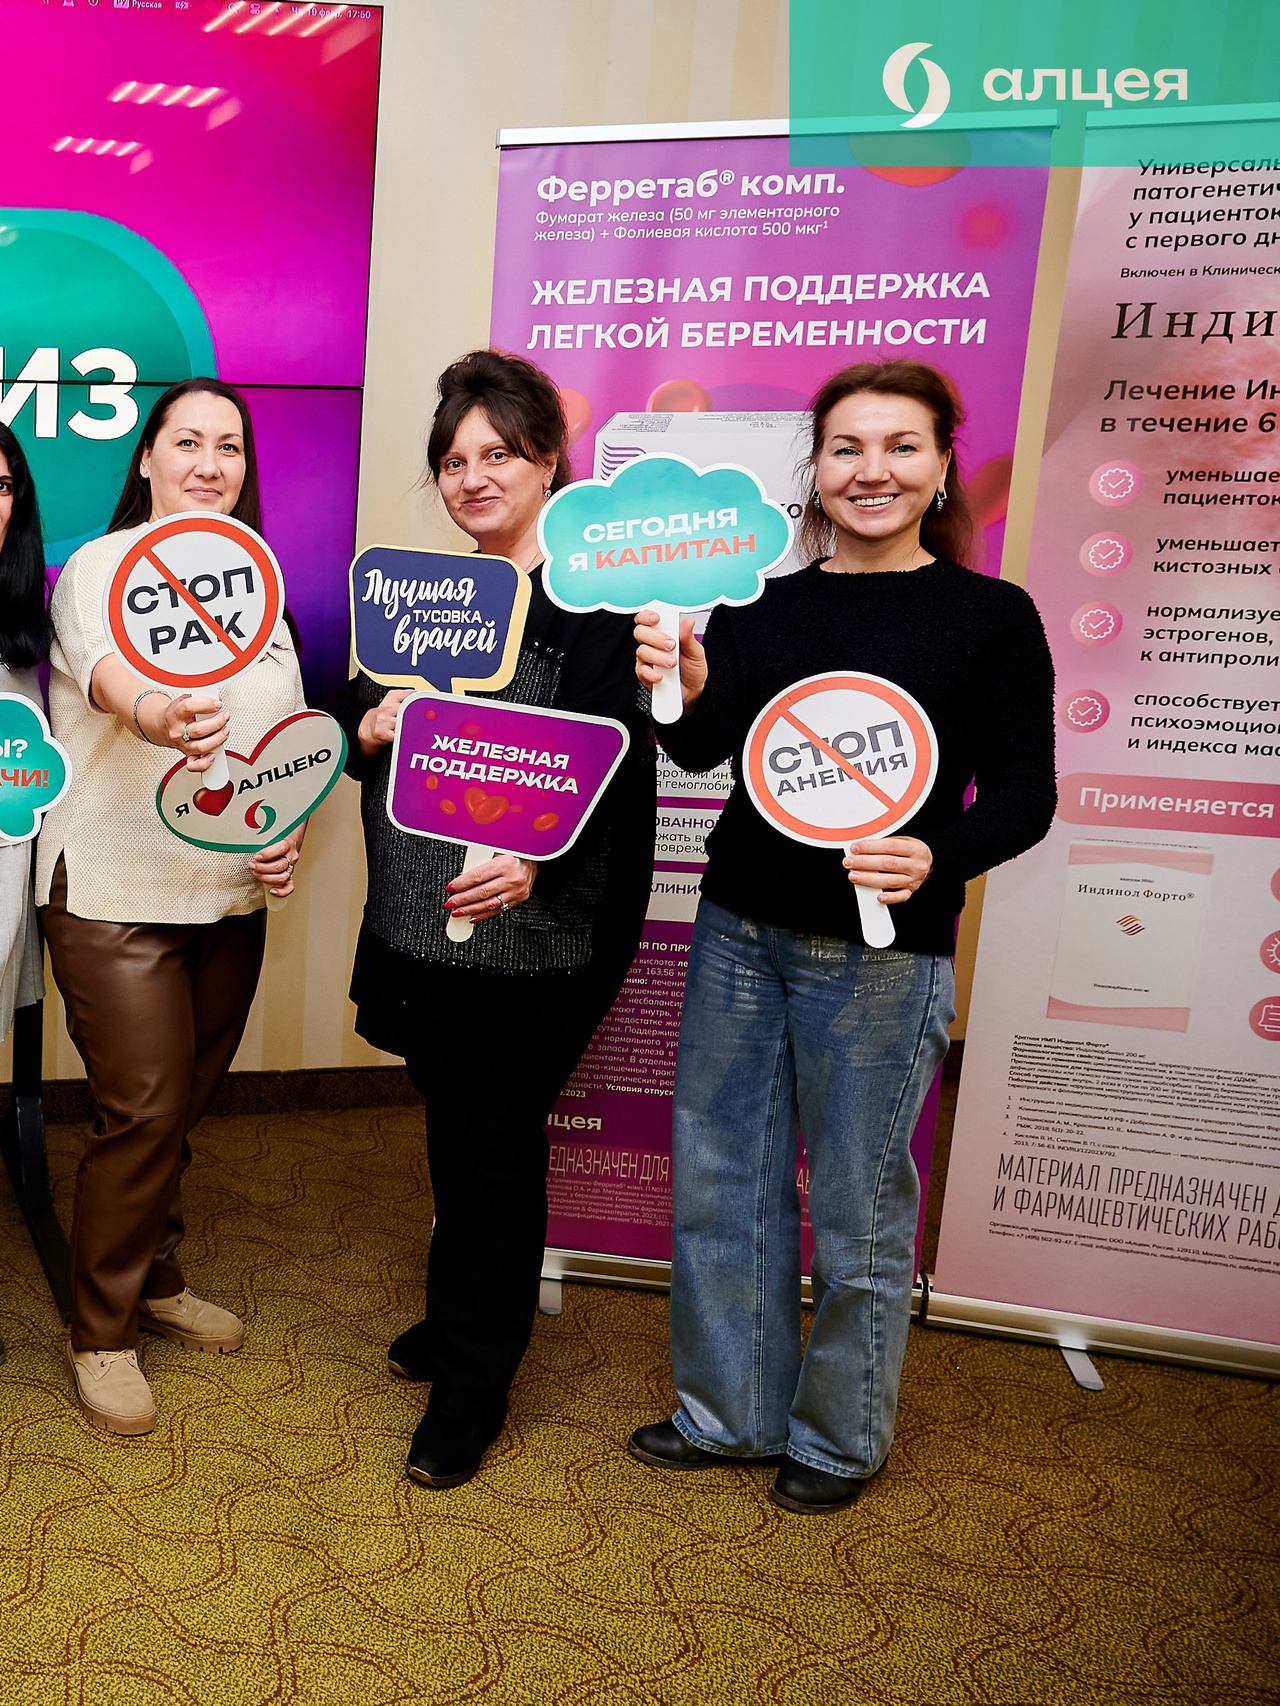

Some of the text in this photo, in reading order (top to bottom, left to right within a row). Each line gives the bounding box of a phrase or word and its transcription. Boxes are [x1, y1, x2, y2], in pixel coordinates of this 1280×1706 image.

[740, 173, 845, 197] комп.
[536, 205, 840, 225] Фумарат железа (50 мг элементарного
[1128, 211, 1143, 229] у
[534, 226, 595, 242] железа)
[613, 226, 690, 240] Фолиевая
[695, 224, 757, 238] кислота
[762, 223, 791, 236] 500
[1125, 235, 1138, 249] с
[1144, 232, 1247, 252] первого
[1120, 267, 1185, 278] Включен
[1189, 268, 1198, 277] в
[531, 270, 991, 306] ЖЕЛЕЗНАЯ ПОДДЕРЖКА
[527, 316, 987, 350] ЛЕГКОЙ БЕРЕМЕННОСТИ
[1111, 302, 1278, 344] Инди
[1103, 379, 1236, 401] Лечение
[1100, 412, 1277, 433] в течение 6
[583, 506, 738, 545] СЕГОДНЯ
[568, 533, 756, 573] Я КАПИТАН
[1156, 539, 1280, 553] уменьшает
[1153, 561, 1273, 575] кистозных
[127, 566, 255, 616] СТОП
[362, 568, 477, 620] Лучшая
[413, 607, 482, 625] ТУСОВКА
[1147, 606, 1280, 624] нормализуе
[149, 610, 248, 655] РАК
[392, 619, 498, 667] врачей
[1143, 628, 1273, 646] эстрогенов,
[1140, 650, 1279, 669] к антипроли
[1133, 693, 1280, 714] способствует
[430, 733, 570, 770] ЖЕЛЕЗНАЯ
[767, 720, 904, 774] СТОП
[1127, 738, 1140, 749] и
[1146, 739, 1237, 754] индекса
[175, 747, 333, 819] Я АЛЦЕЮ
[409, 752, 579, 795] ПОДДЕРЖКА
[775, 752, 909, 796] АНЕМИЯ
[1079, 786, 1275, 819] Применяется
[655, 833, 691, 843] жать
[1078, 884, 1140, 898] Индинол
[651, 942, 668, 951] ПО
[605, 1083, 643, 1093] Условия
[639, 1154, 670, 1185] ДЛЯ
[997, 1153, 1101, 1192] МАТЕРИАЛ
[1107, 1166, 1268, 1214] ПРЕДНАЗНАЧЕН
[993, 1185, 1006, 1211] И
[1014, 1188, 1230, 1242] ФАРМАЦЕВТИЧЕСКИХ
